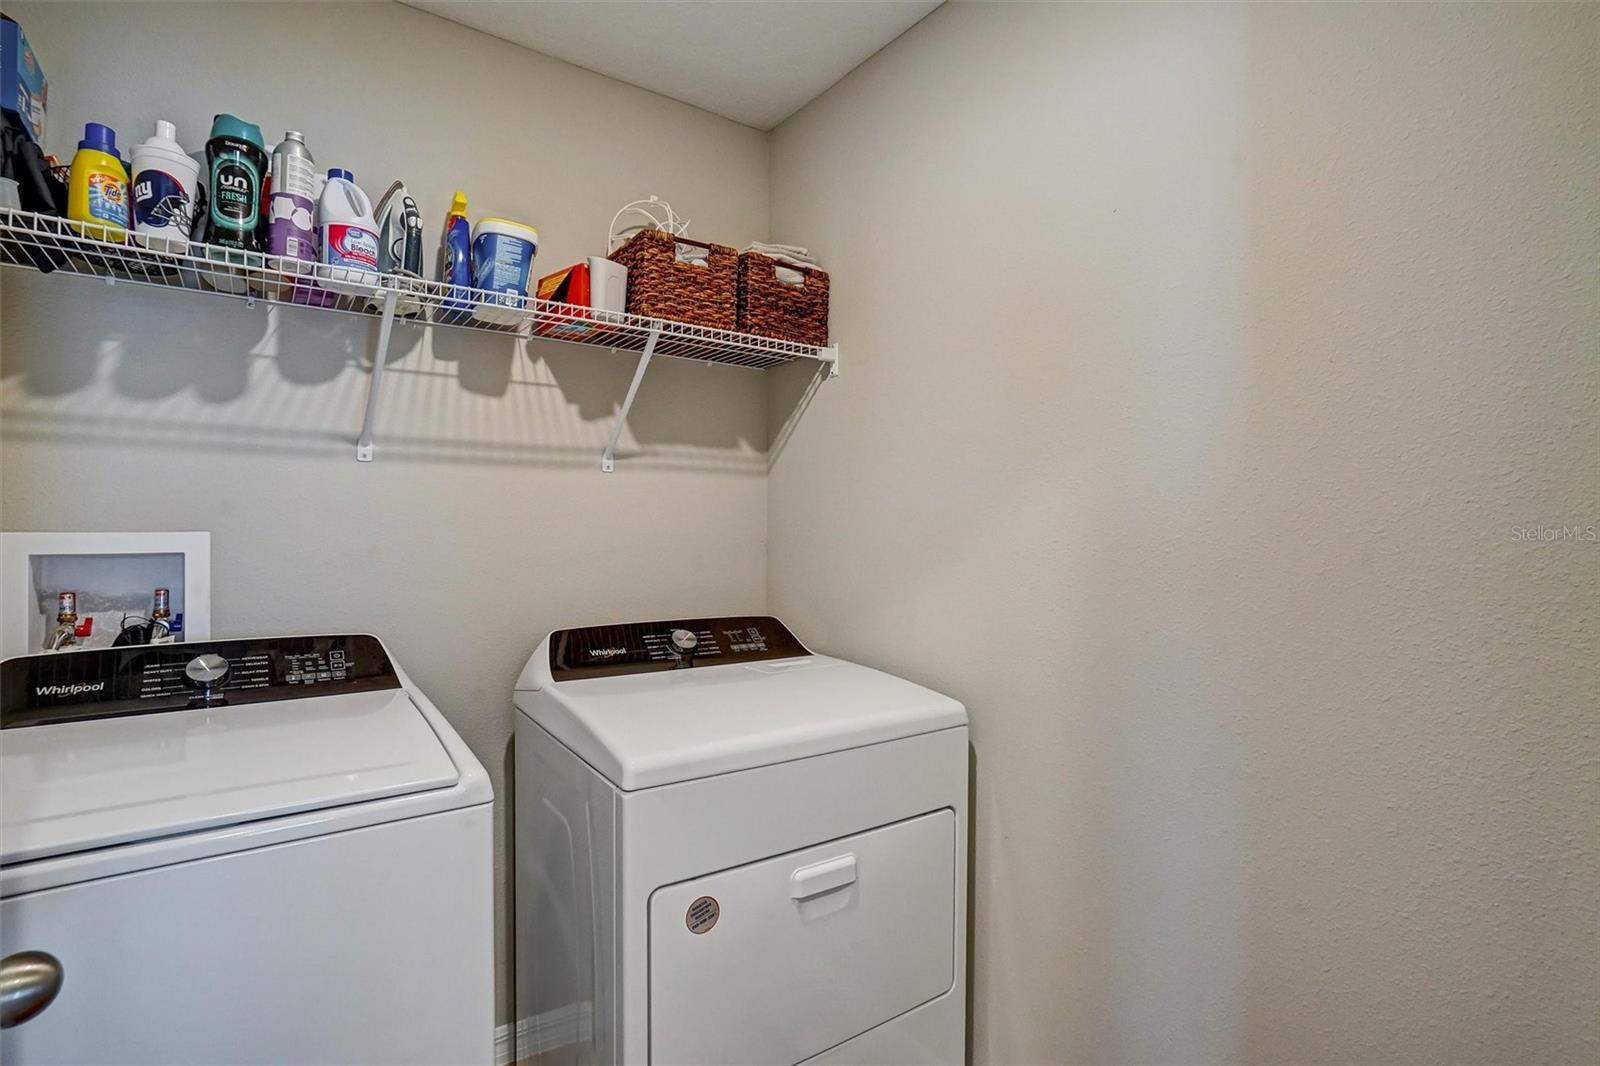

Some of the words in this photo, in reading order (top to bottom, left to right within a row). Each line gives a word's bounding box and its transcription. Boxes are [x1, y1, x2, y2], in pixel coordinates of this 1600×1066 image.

[104, 184, 122, 198] Tide
[221, 191, 247, 203] FRESH
[351, 243, 376, 256] Bleach
[589, 648, 627, 658] Whirlpool
[36, 682, 105, 698] Whirlpool
